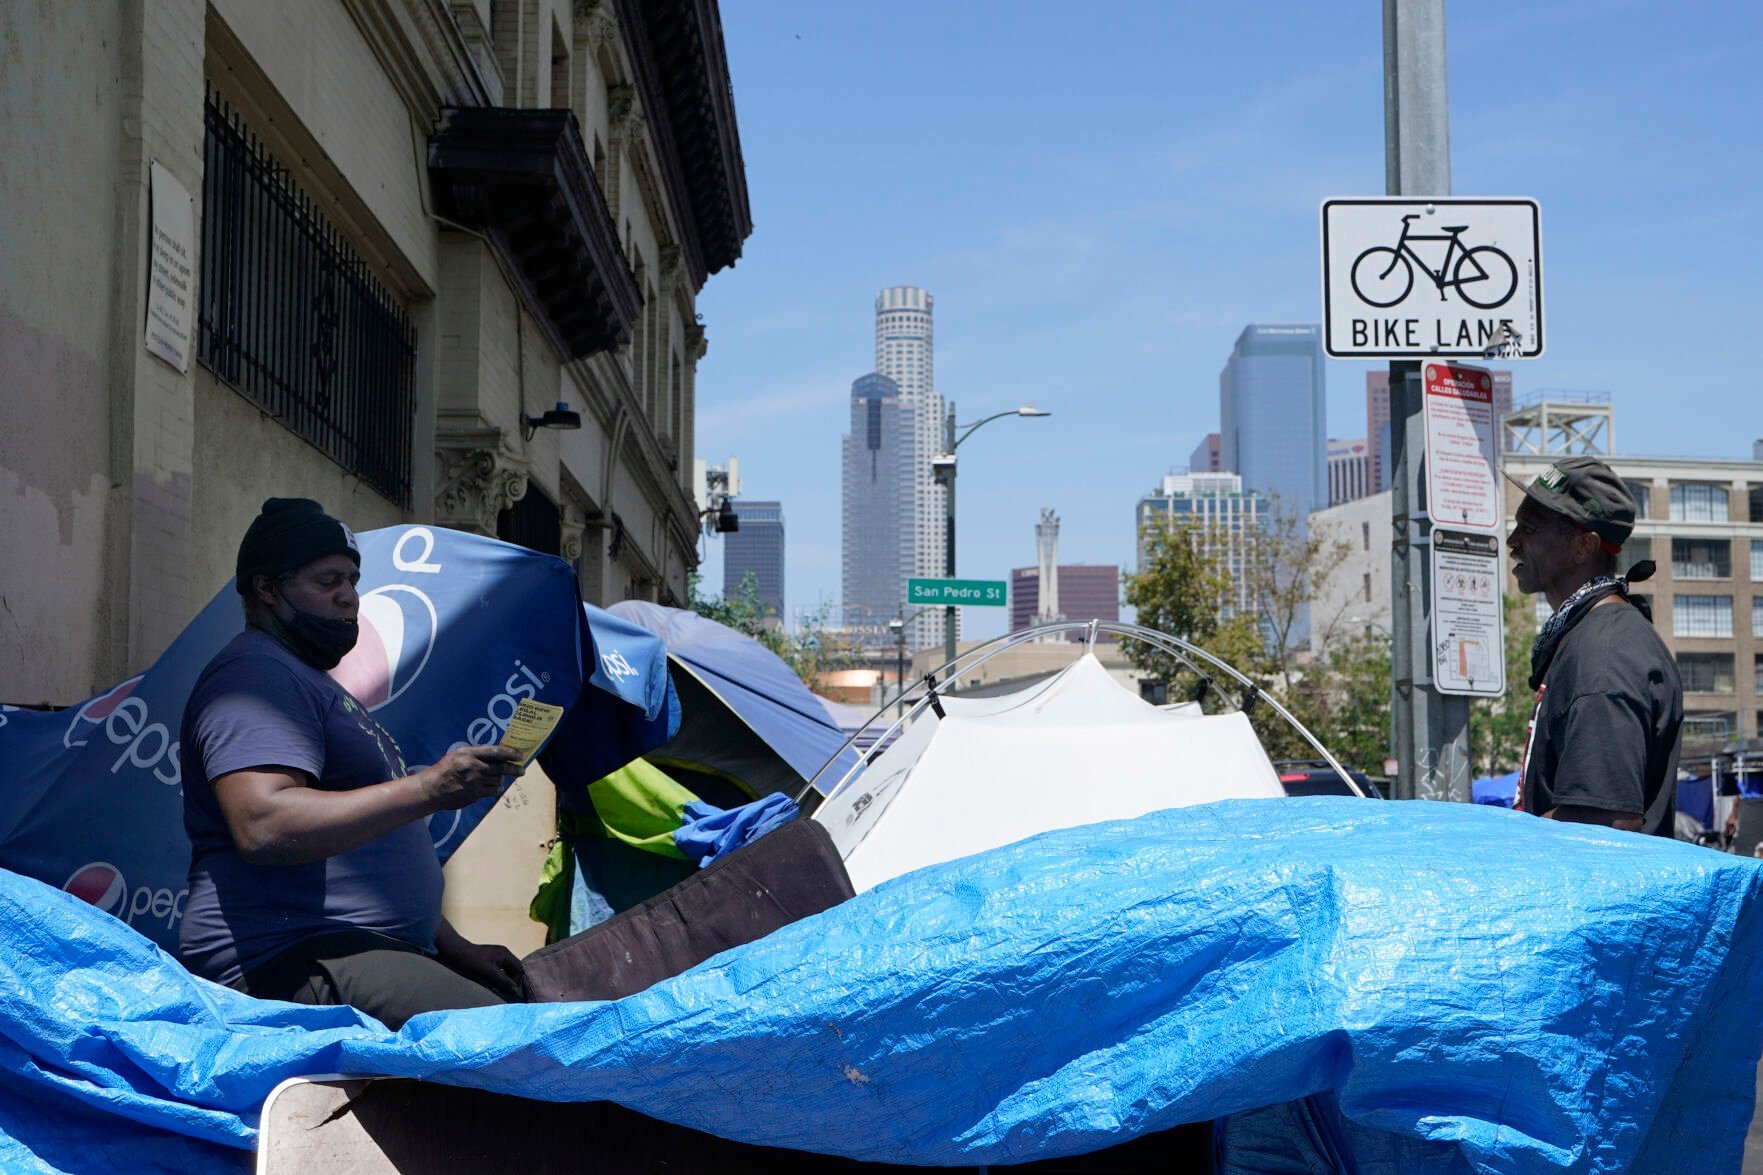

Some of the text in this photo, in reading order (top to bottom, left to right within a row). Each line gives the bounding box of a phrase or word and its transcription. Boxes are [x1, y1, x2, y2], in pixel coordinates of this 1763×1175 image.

[1352, 318, 1419, 347] BIKE
[1431, 385, 1488, 400] CALLES SALUDABLES
[914, 585, 1000, 599] San Pedro St
[446, 659, 545, 753] epsi
